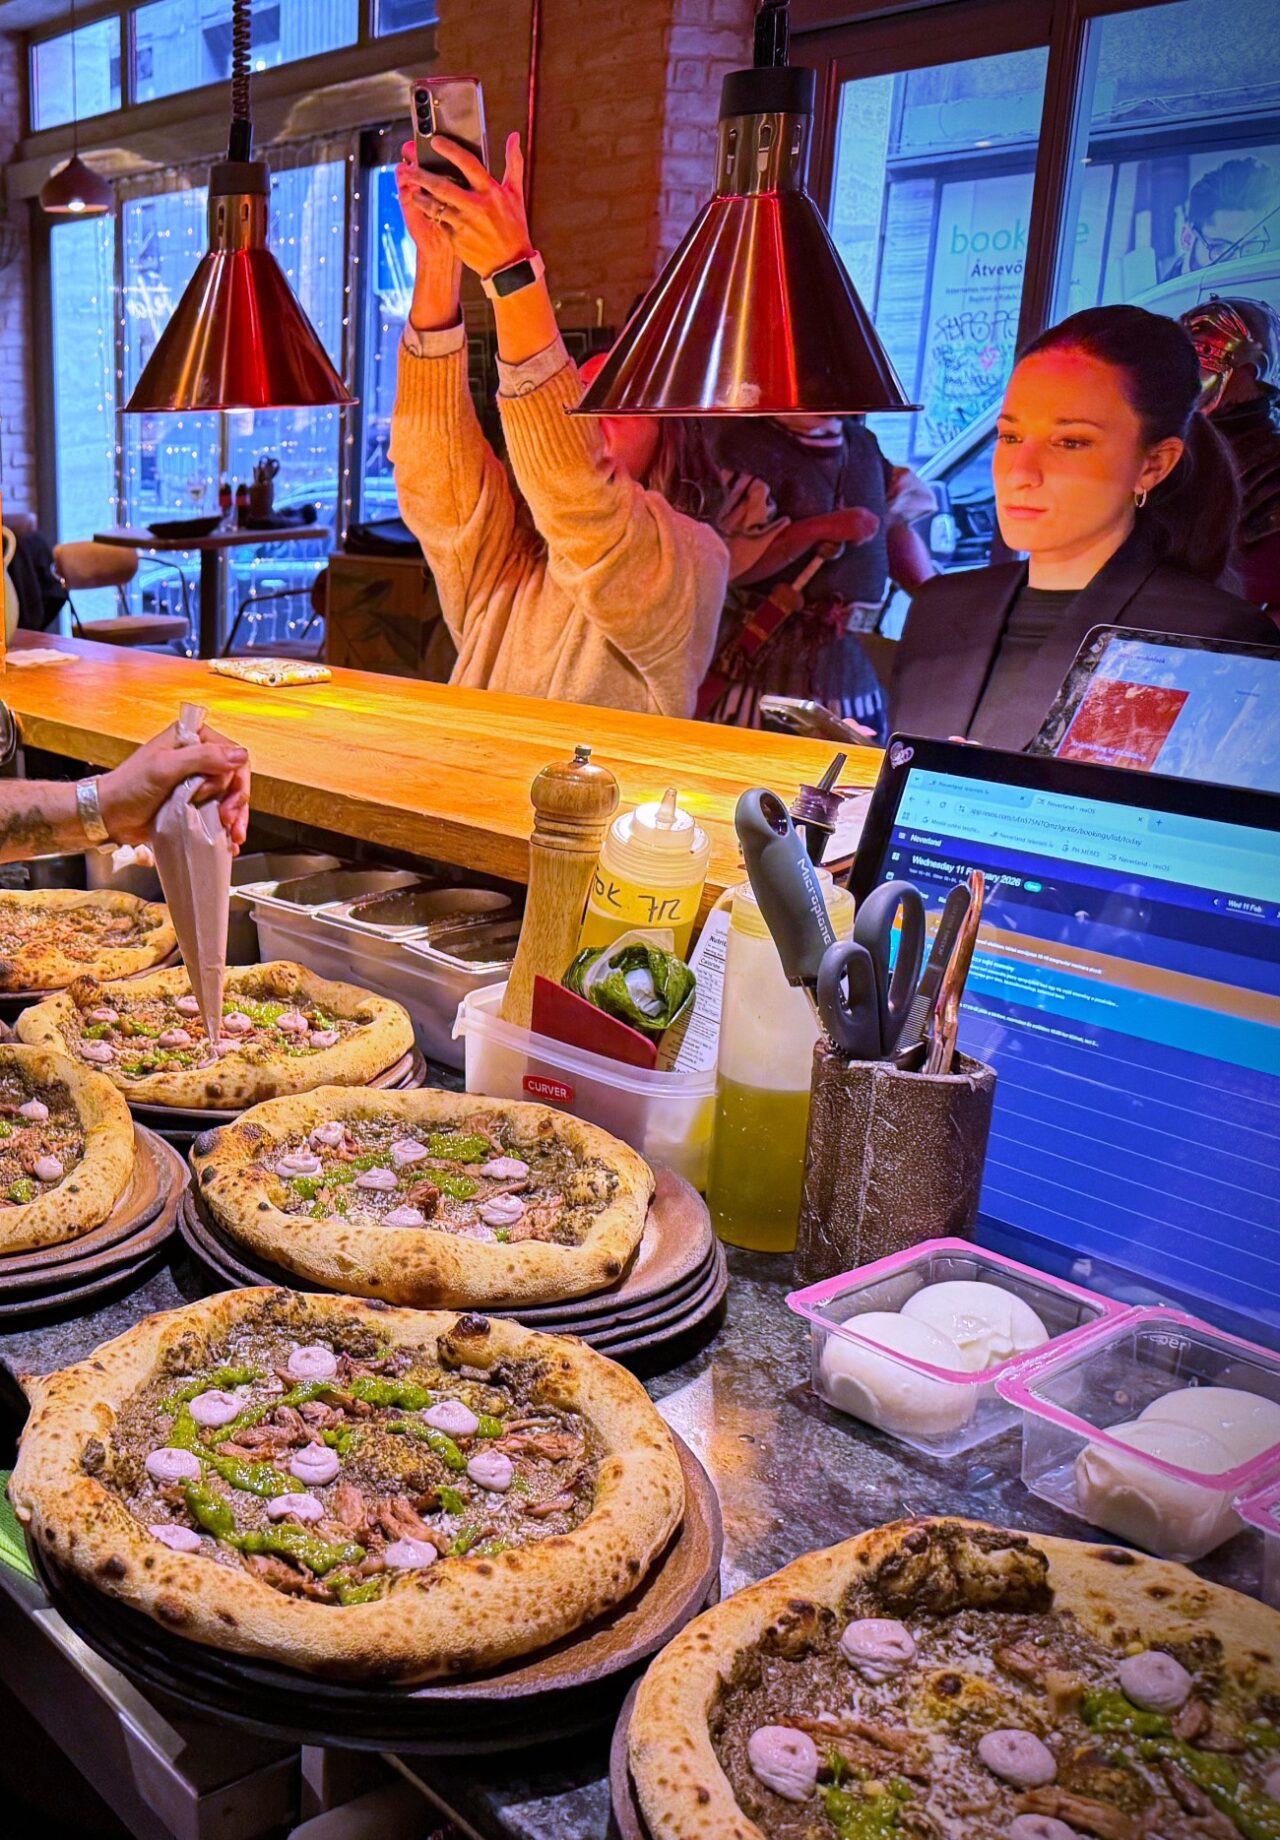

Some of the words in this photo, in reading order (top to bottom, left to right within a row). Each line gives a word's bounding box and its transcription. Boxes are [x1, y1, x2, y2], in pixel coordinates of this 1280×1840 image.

[912, 854, 955, 874] Wednesday
[798, 858, 832, 945] Microplane
[528, 1080, 567, 1099] CURVER
